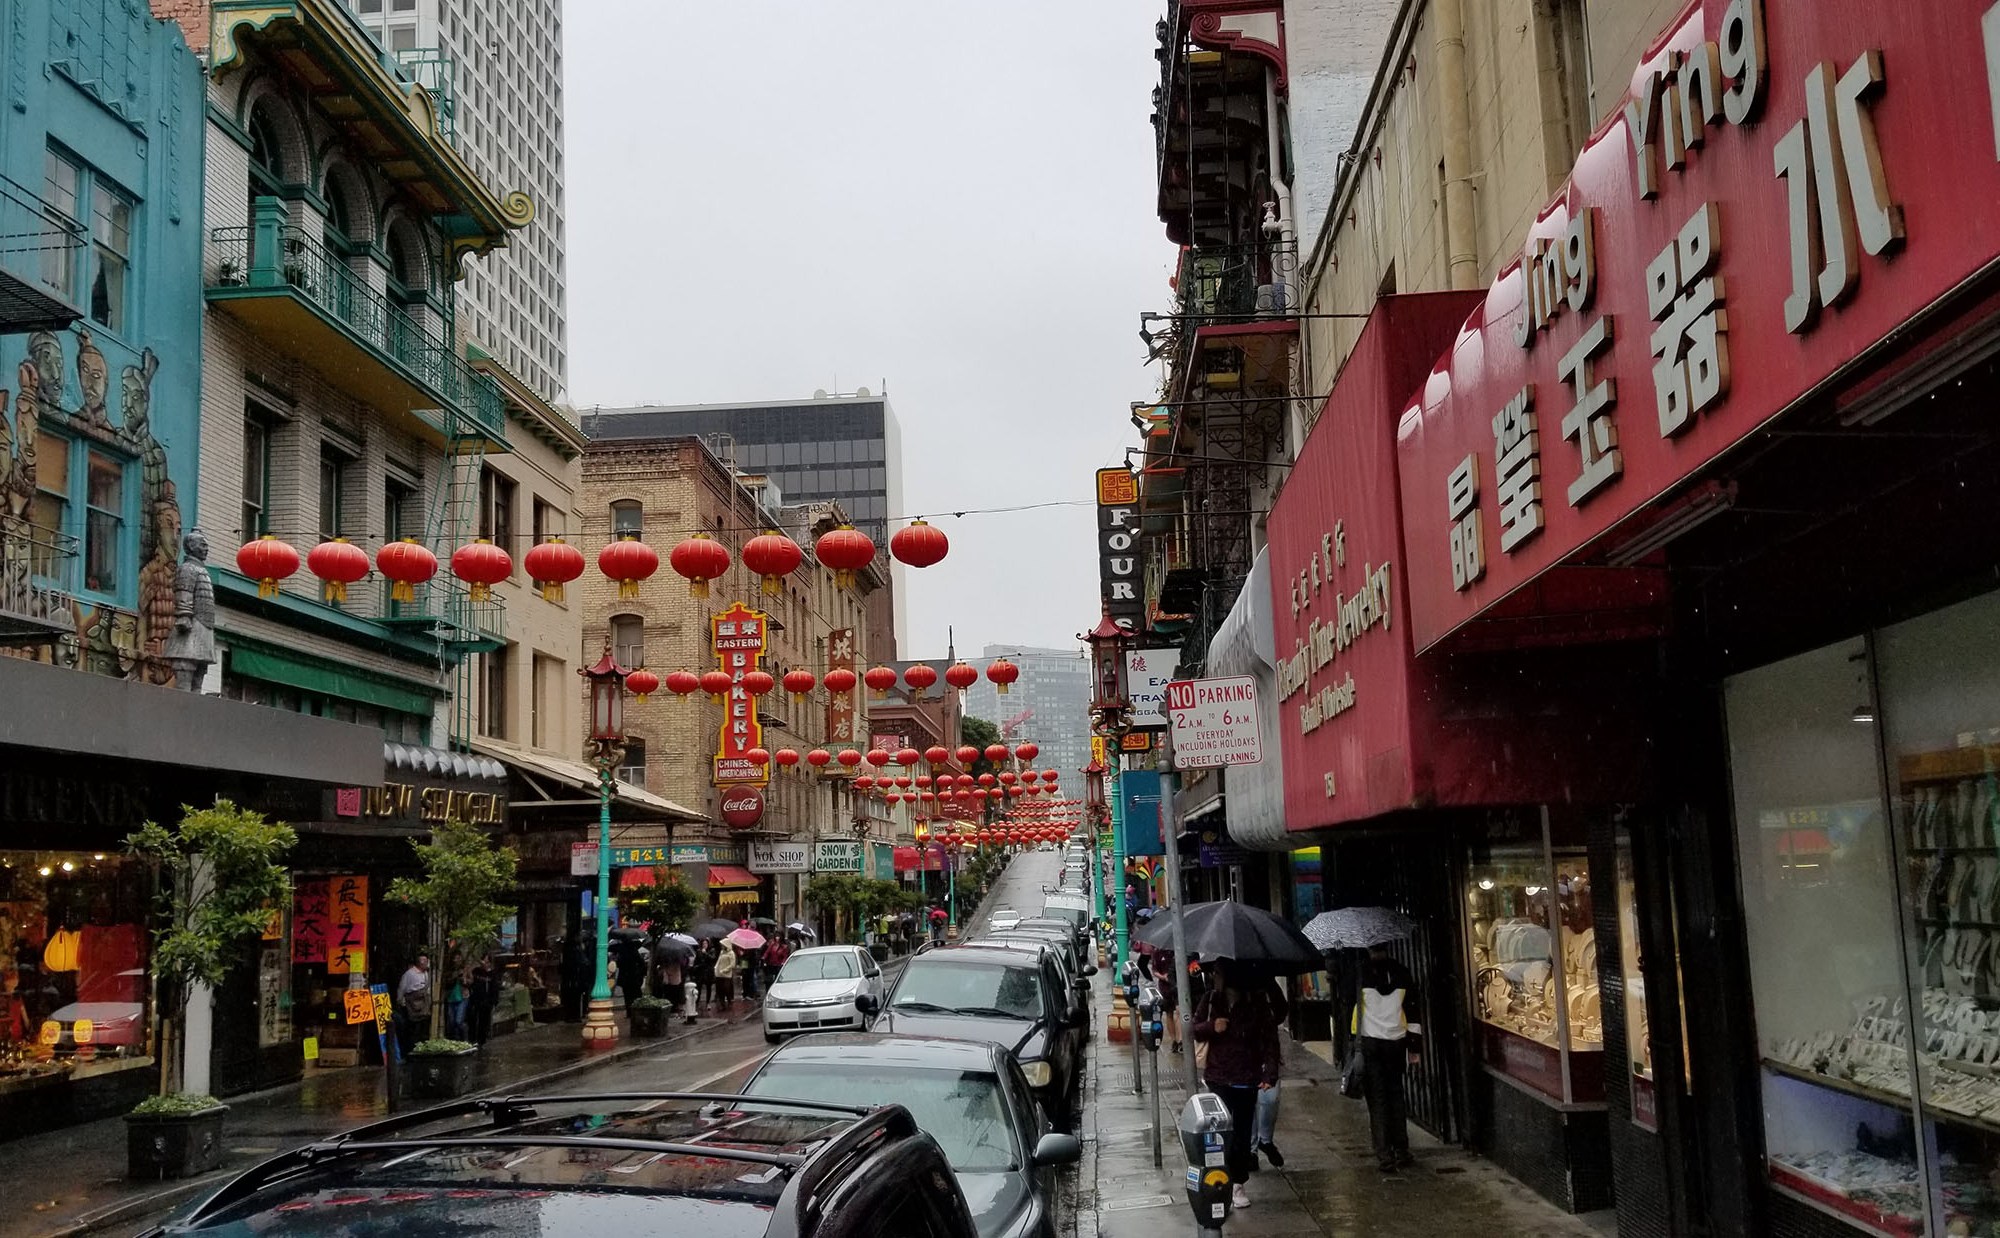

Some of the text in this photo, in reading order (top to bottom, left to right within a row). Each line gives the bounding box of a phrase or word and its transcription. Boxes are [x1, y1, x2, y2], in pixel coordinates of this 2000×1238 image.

[1511, 0, 1769, 349] Jing Ying
[1309, 616, 1336, 675] Fine
[1336, 560, 1392, 652] Jewelry
[716, 637, 762, 648] EASTERN
[1130, 656, 1148, 672] 德
[732, 652, 748, 751] BAKERY
[1170, 684, 1253, 708] NO PARKING
[1176, 713, 1186, 729] 2
[1189, 719, 1206, 728] A.M.
[1223, 709, 1232, 725] 6
[1236, 715, 1253, 724] A.M.
[1196, 729, 1234, 740] EVERYDAY
[1177, 737, 1256, 752] INCLUDING HOLIDAYS
[718, 759, 754, 768] CHINESE
[1181, 752, 1256, 766] STREET CLEANING
[364, 781, 416, 817] NEW
[420, 786, 505, 825] SHANGHAI
[755, 851, 804, 862] WOK SHOP
[821, 845, 847, 856] SNOW
[816, 858, 850, 869] GARDEN
